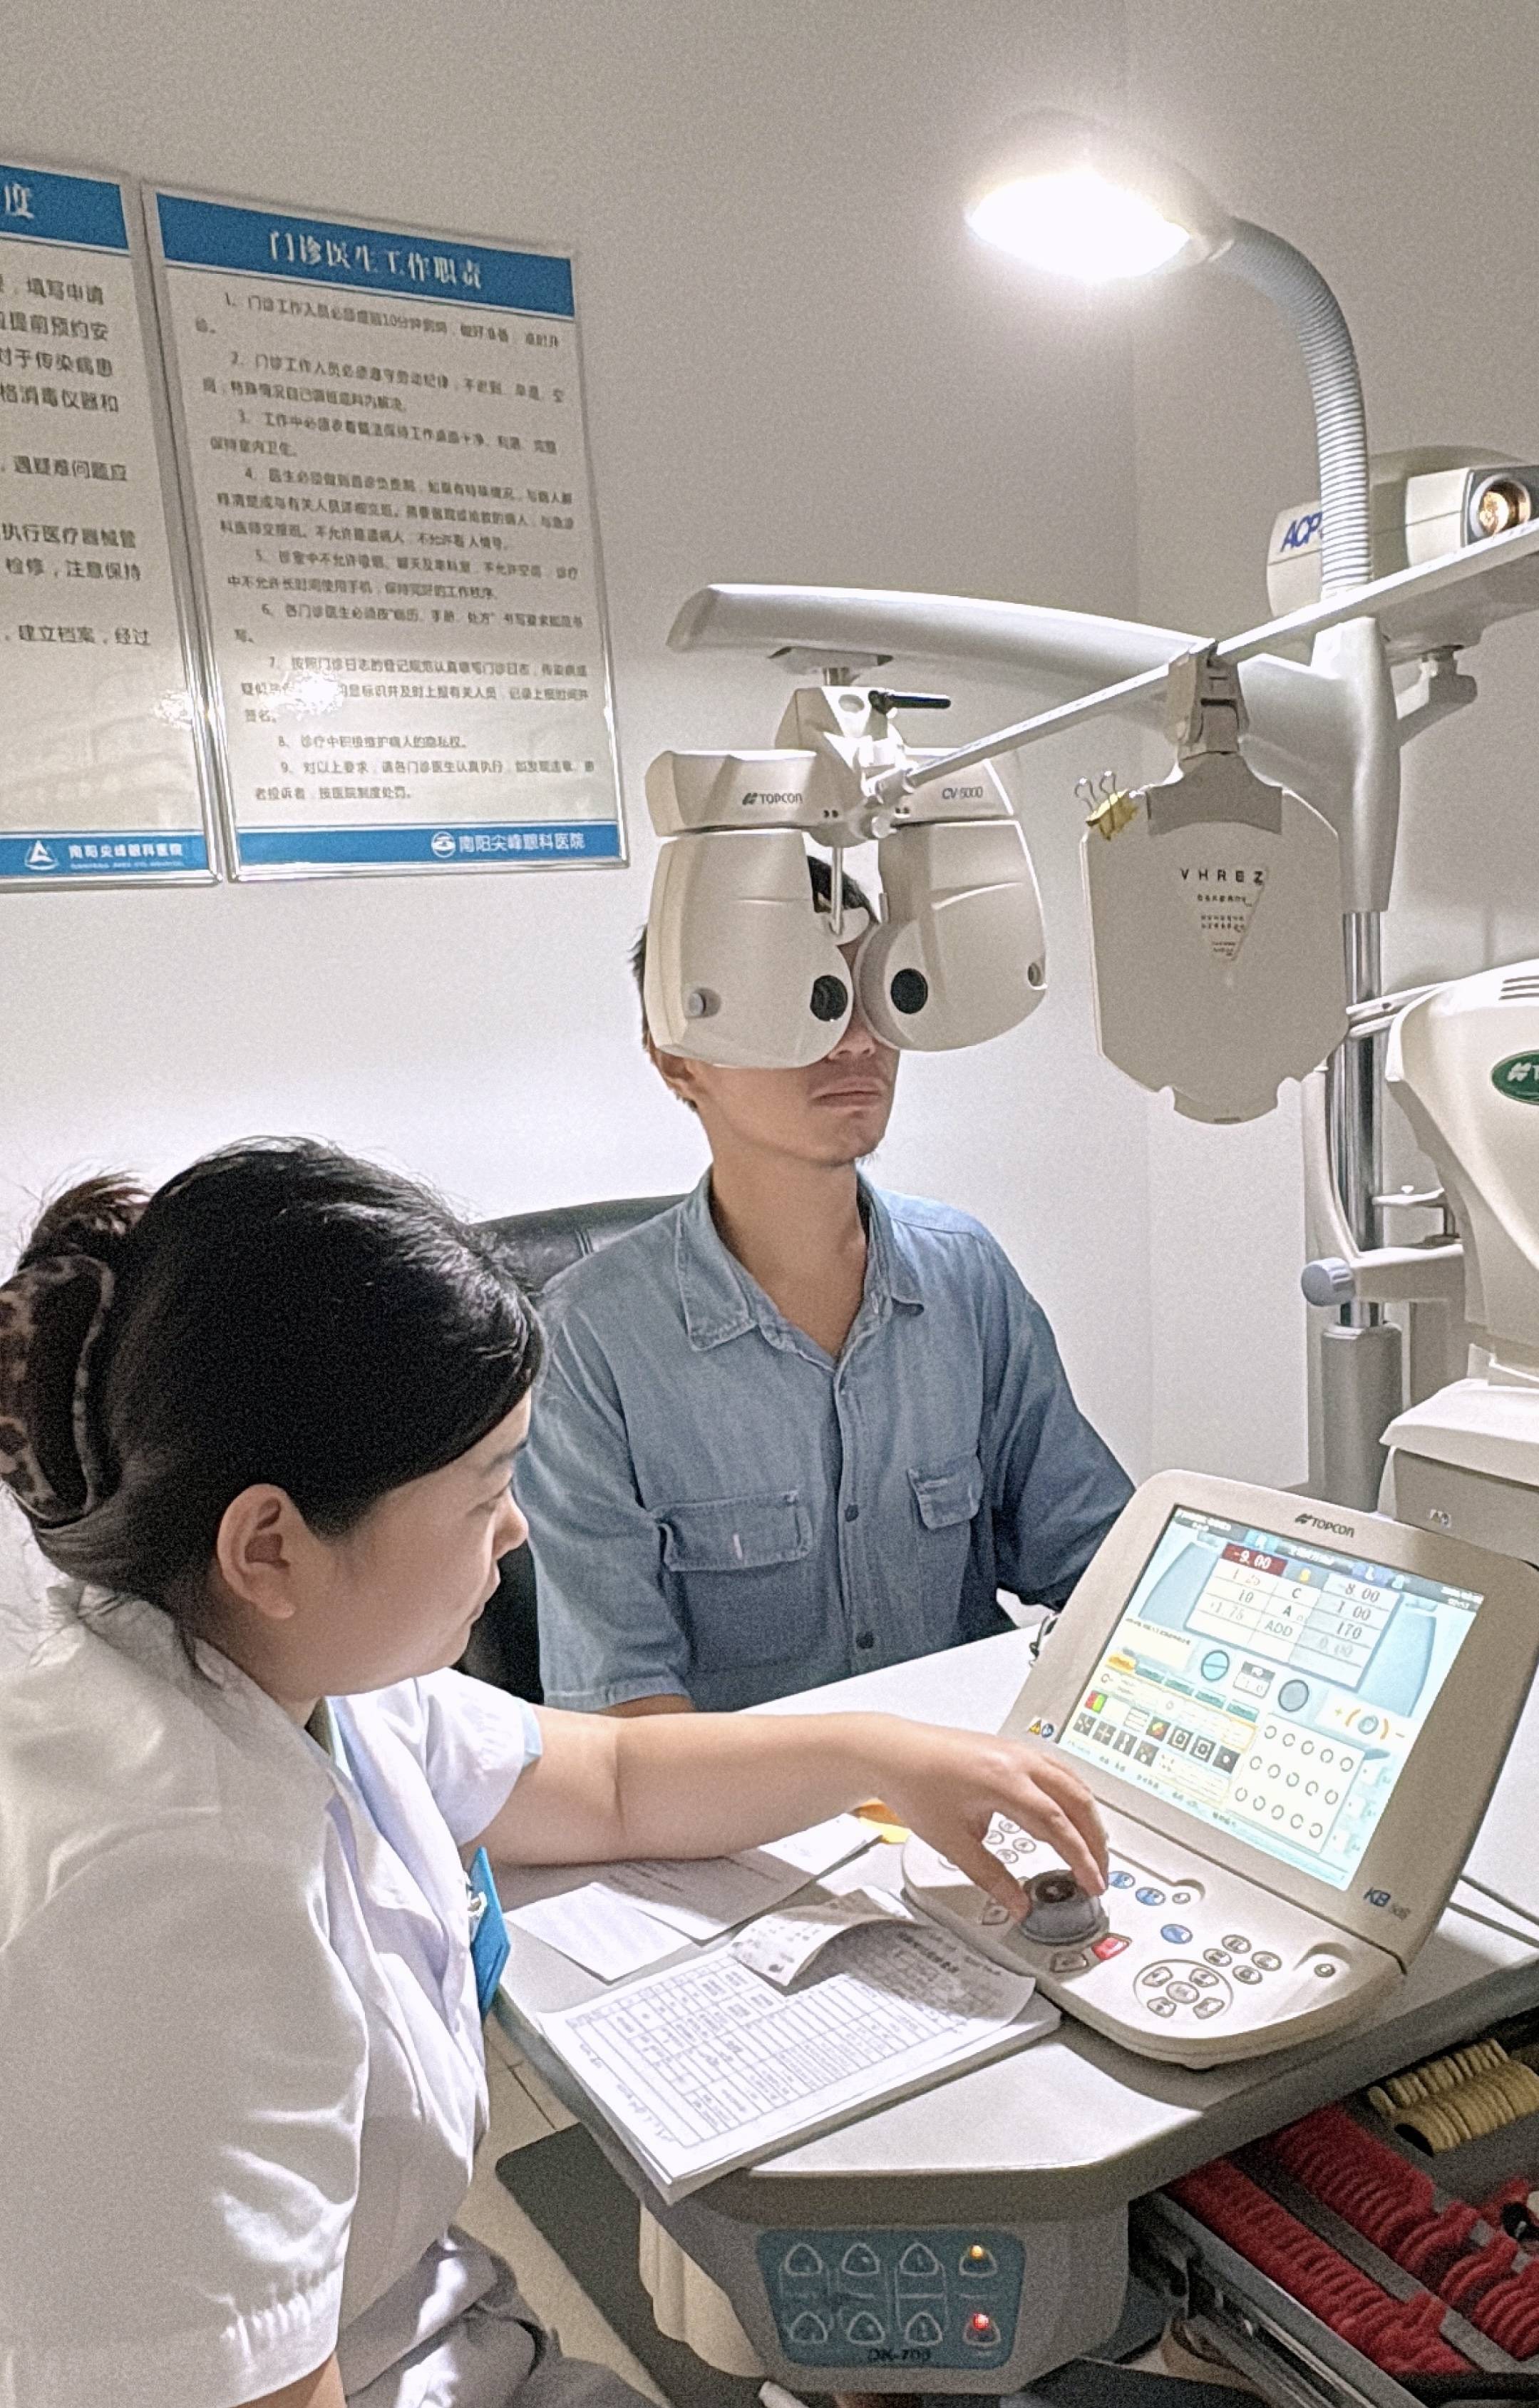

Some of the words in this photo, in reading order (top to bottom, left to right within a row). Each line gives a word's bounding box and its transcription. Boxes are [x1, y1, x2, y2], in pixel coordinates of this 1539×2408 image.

[269, 230, 482, 288] 门诊医生工作职责
[759, 791, 803, 804] TOPCON
[459, 833, 586, 853] 南阳尖峰眼科医院
[1312, 1517, 1355, 1538] TOPCON
[1292, 1588, 1302, 1599] C
[1264, 1619, 1294, 1637] ADD
[1282, 1605, 1292, 1618] A
[1337, 1621, 1363, 1640] 170
